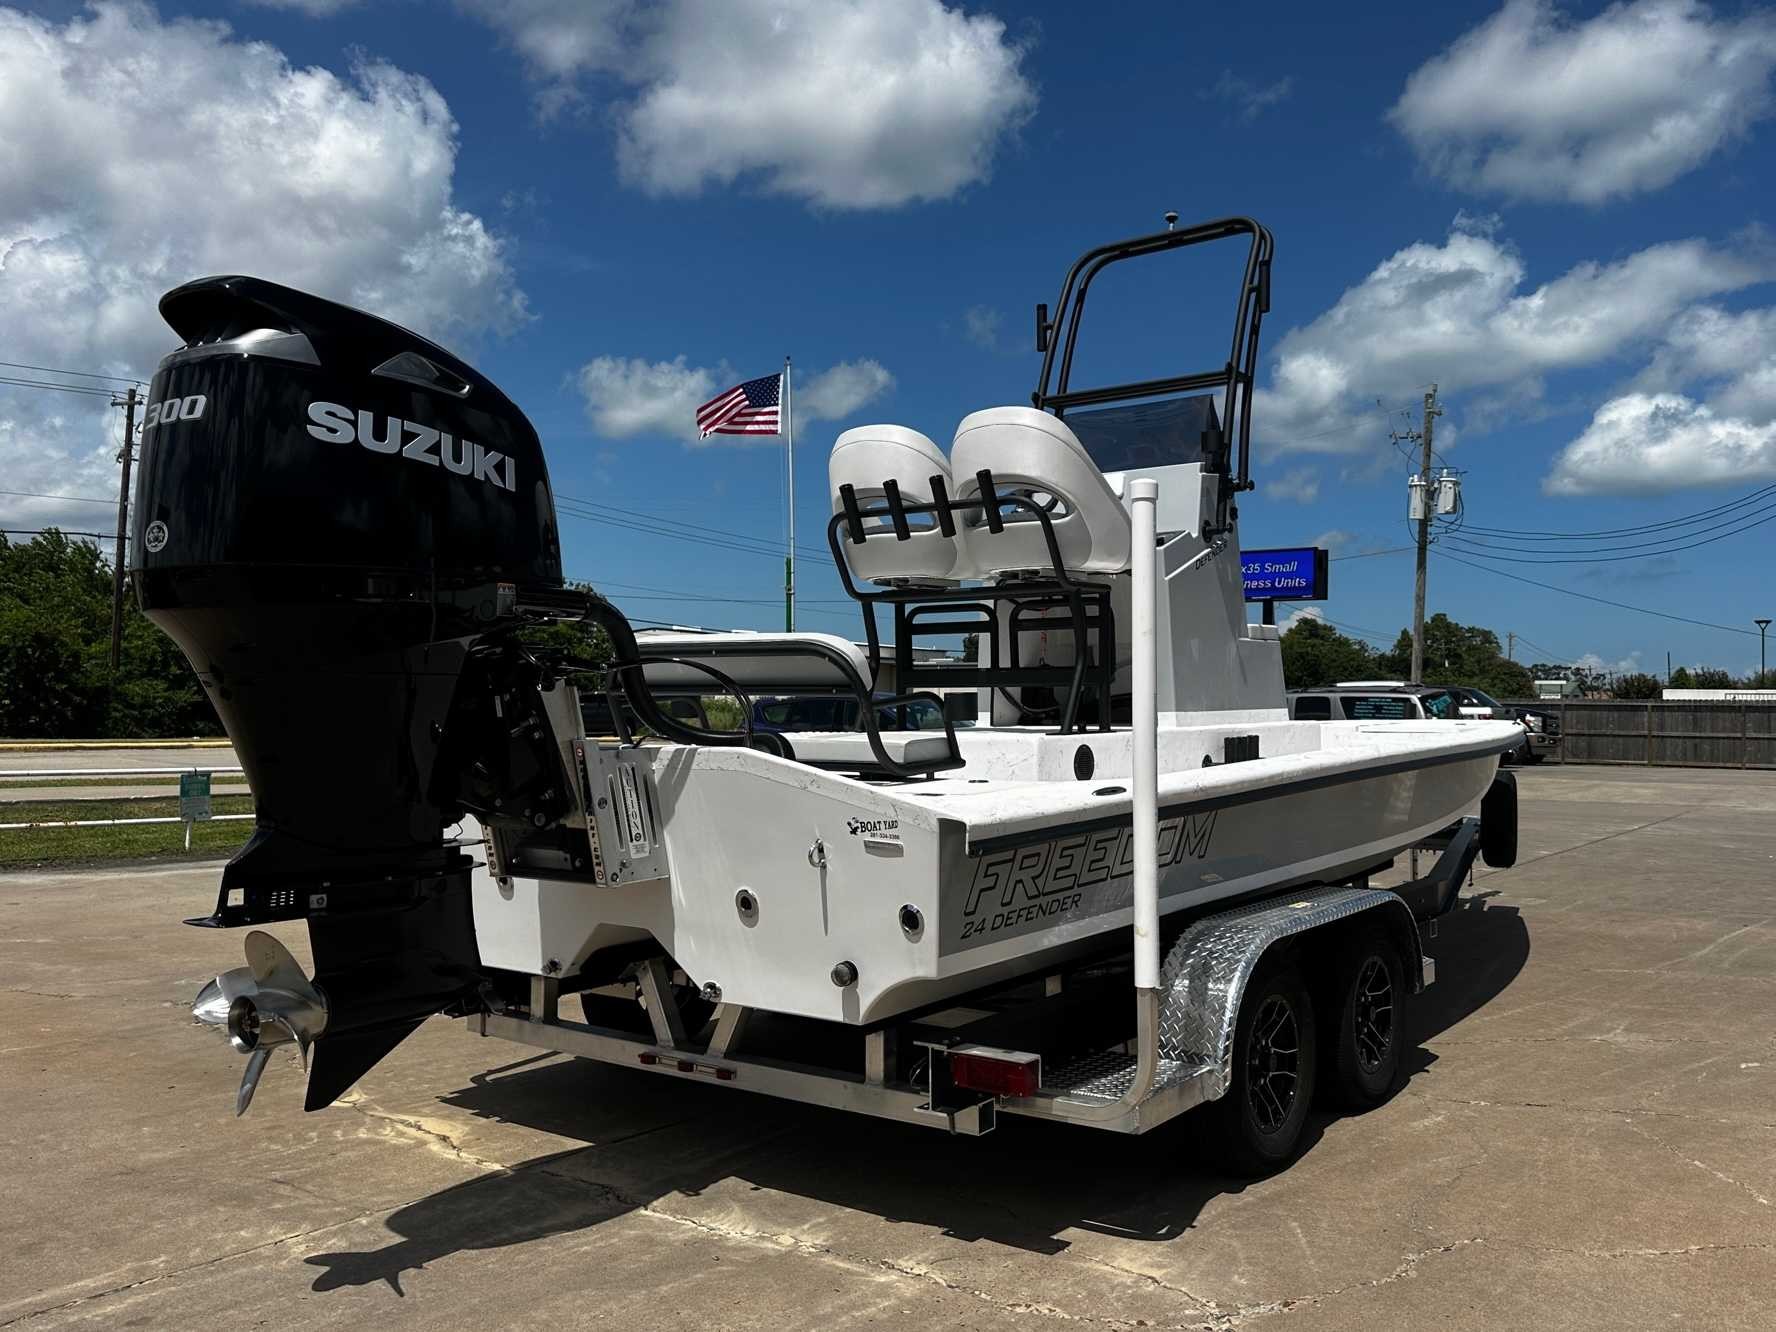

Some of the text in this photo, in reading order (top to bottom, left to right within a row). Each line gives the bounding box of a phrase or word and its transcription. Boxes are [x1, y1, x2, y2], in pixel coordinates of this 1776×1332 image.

[145, 394, 207, 430] 300
[306, 401, 516, 492] SUZUKI
[1241, 560, 1298, 574] x35 Small
[1243, 577, 1307, 589] ness Units
[859, 820, 899, 833] BOAT YARD
[960, 893, 1082, 940] 24 DEFENDER
